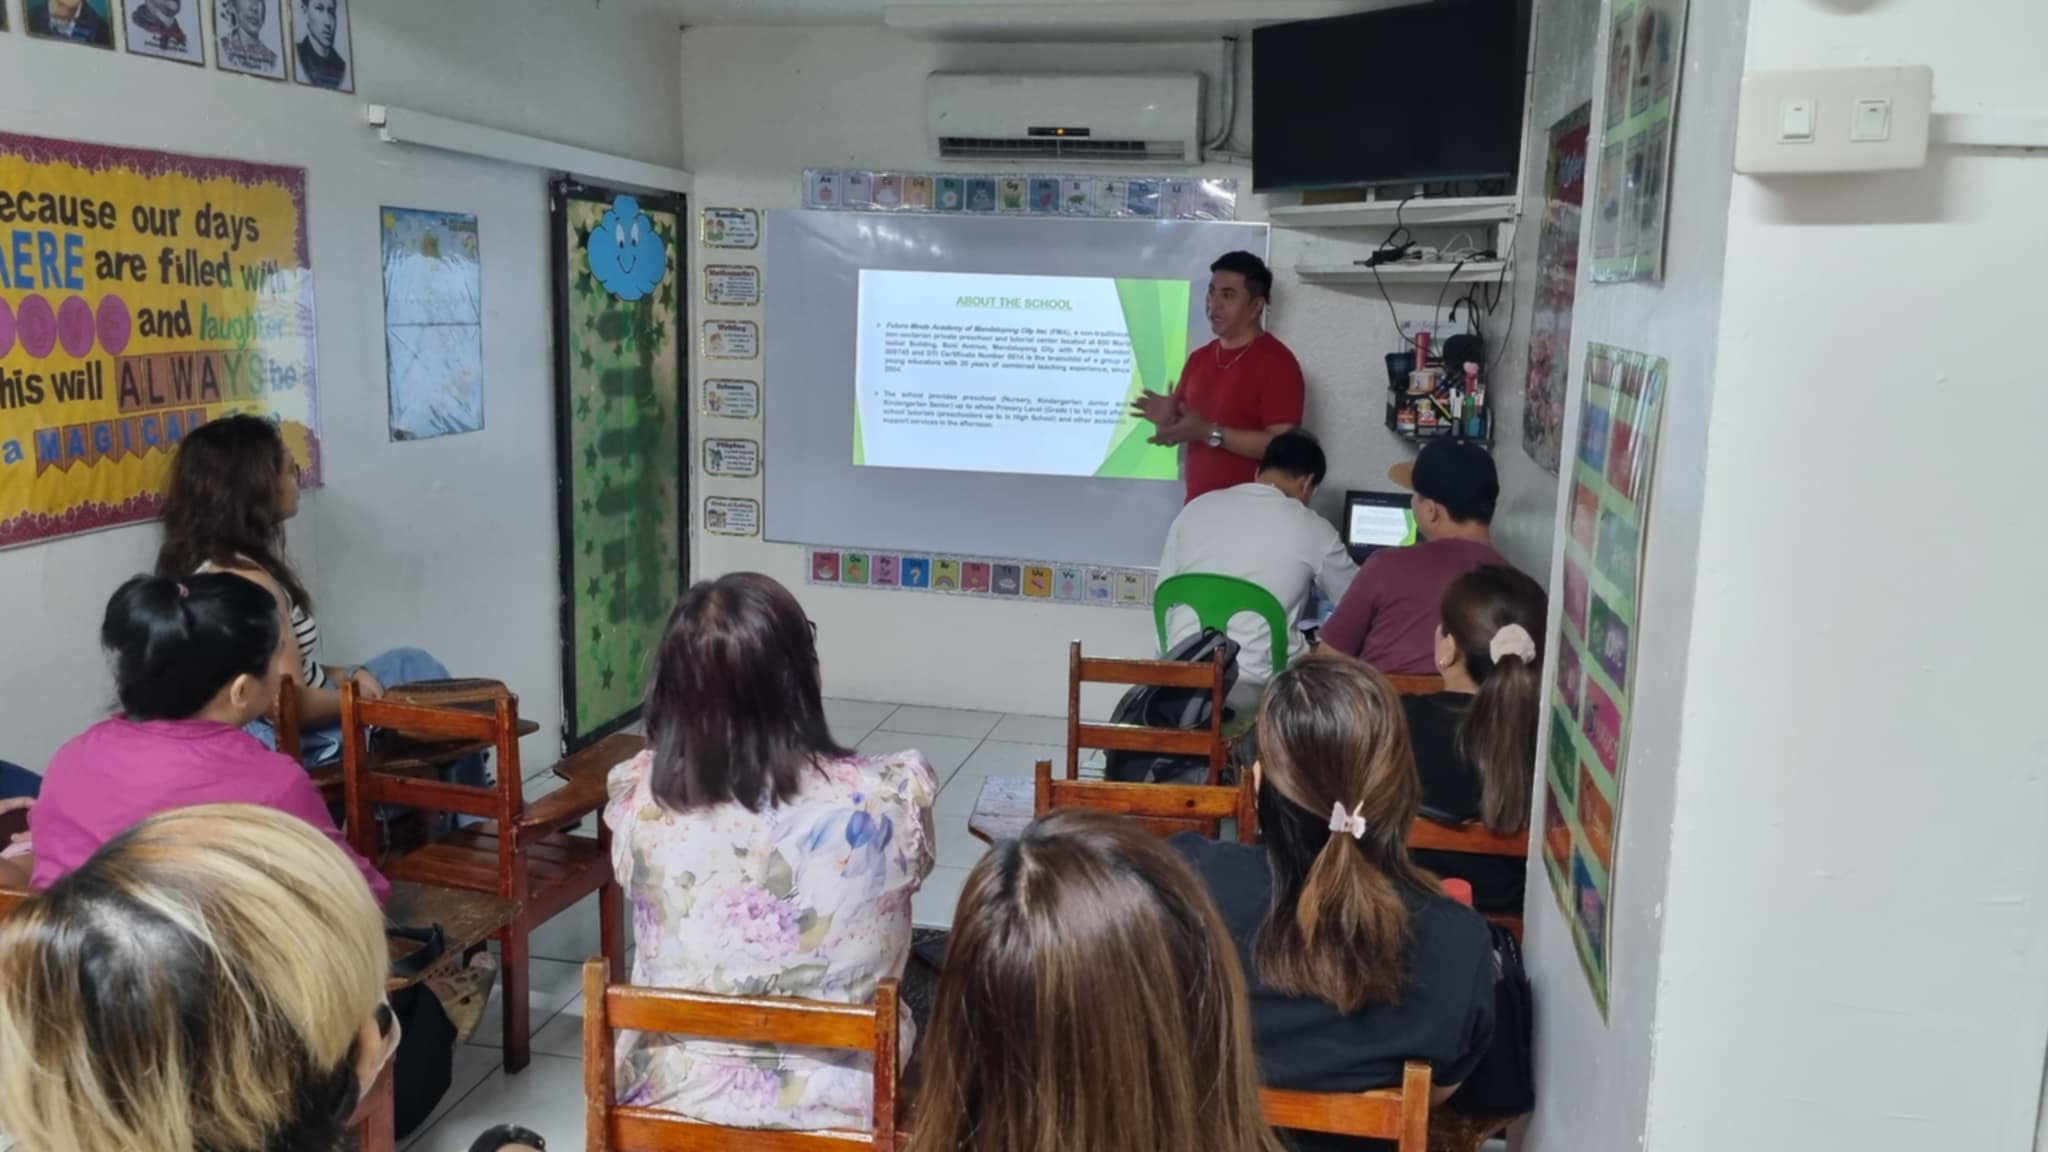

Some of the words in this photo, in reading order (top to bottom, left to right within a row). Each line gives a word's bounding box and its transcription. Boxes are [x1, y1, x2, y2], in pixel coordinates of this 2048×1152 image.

[132, 204, 181, 236] our
[195, 202, 260, 251] days
[0, 229, 84, 290] ERE
[95, 249, 147, 282] are
[158, 247, 233, 288] filled
[956, 295, 994, 308] ABOUT
[999, 296, 1021, 309] THE
[1024, 297, 1072, 310] SCHOOL
[137, 300, 192, 338] and
[930, 323, 962, 333] Academy
[1020, 326, 1033, 335] City
[911, 349, 924, 357] and
[1034, 352, 1044, 361] the
[1040, 344, 1054, 354] City
[51, 360, 103, 402] will
[118, 353, 263, 408] ALWAYS
[1013, 413, 1028, 422] High
[1058, 415, 1071, 423] and
[1094, 408, 1107, 416] and
[2, 439, 24, 465] a
